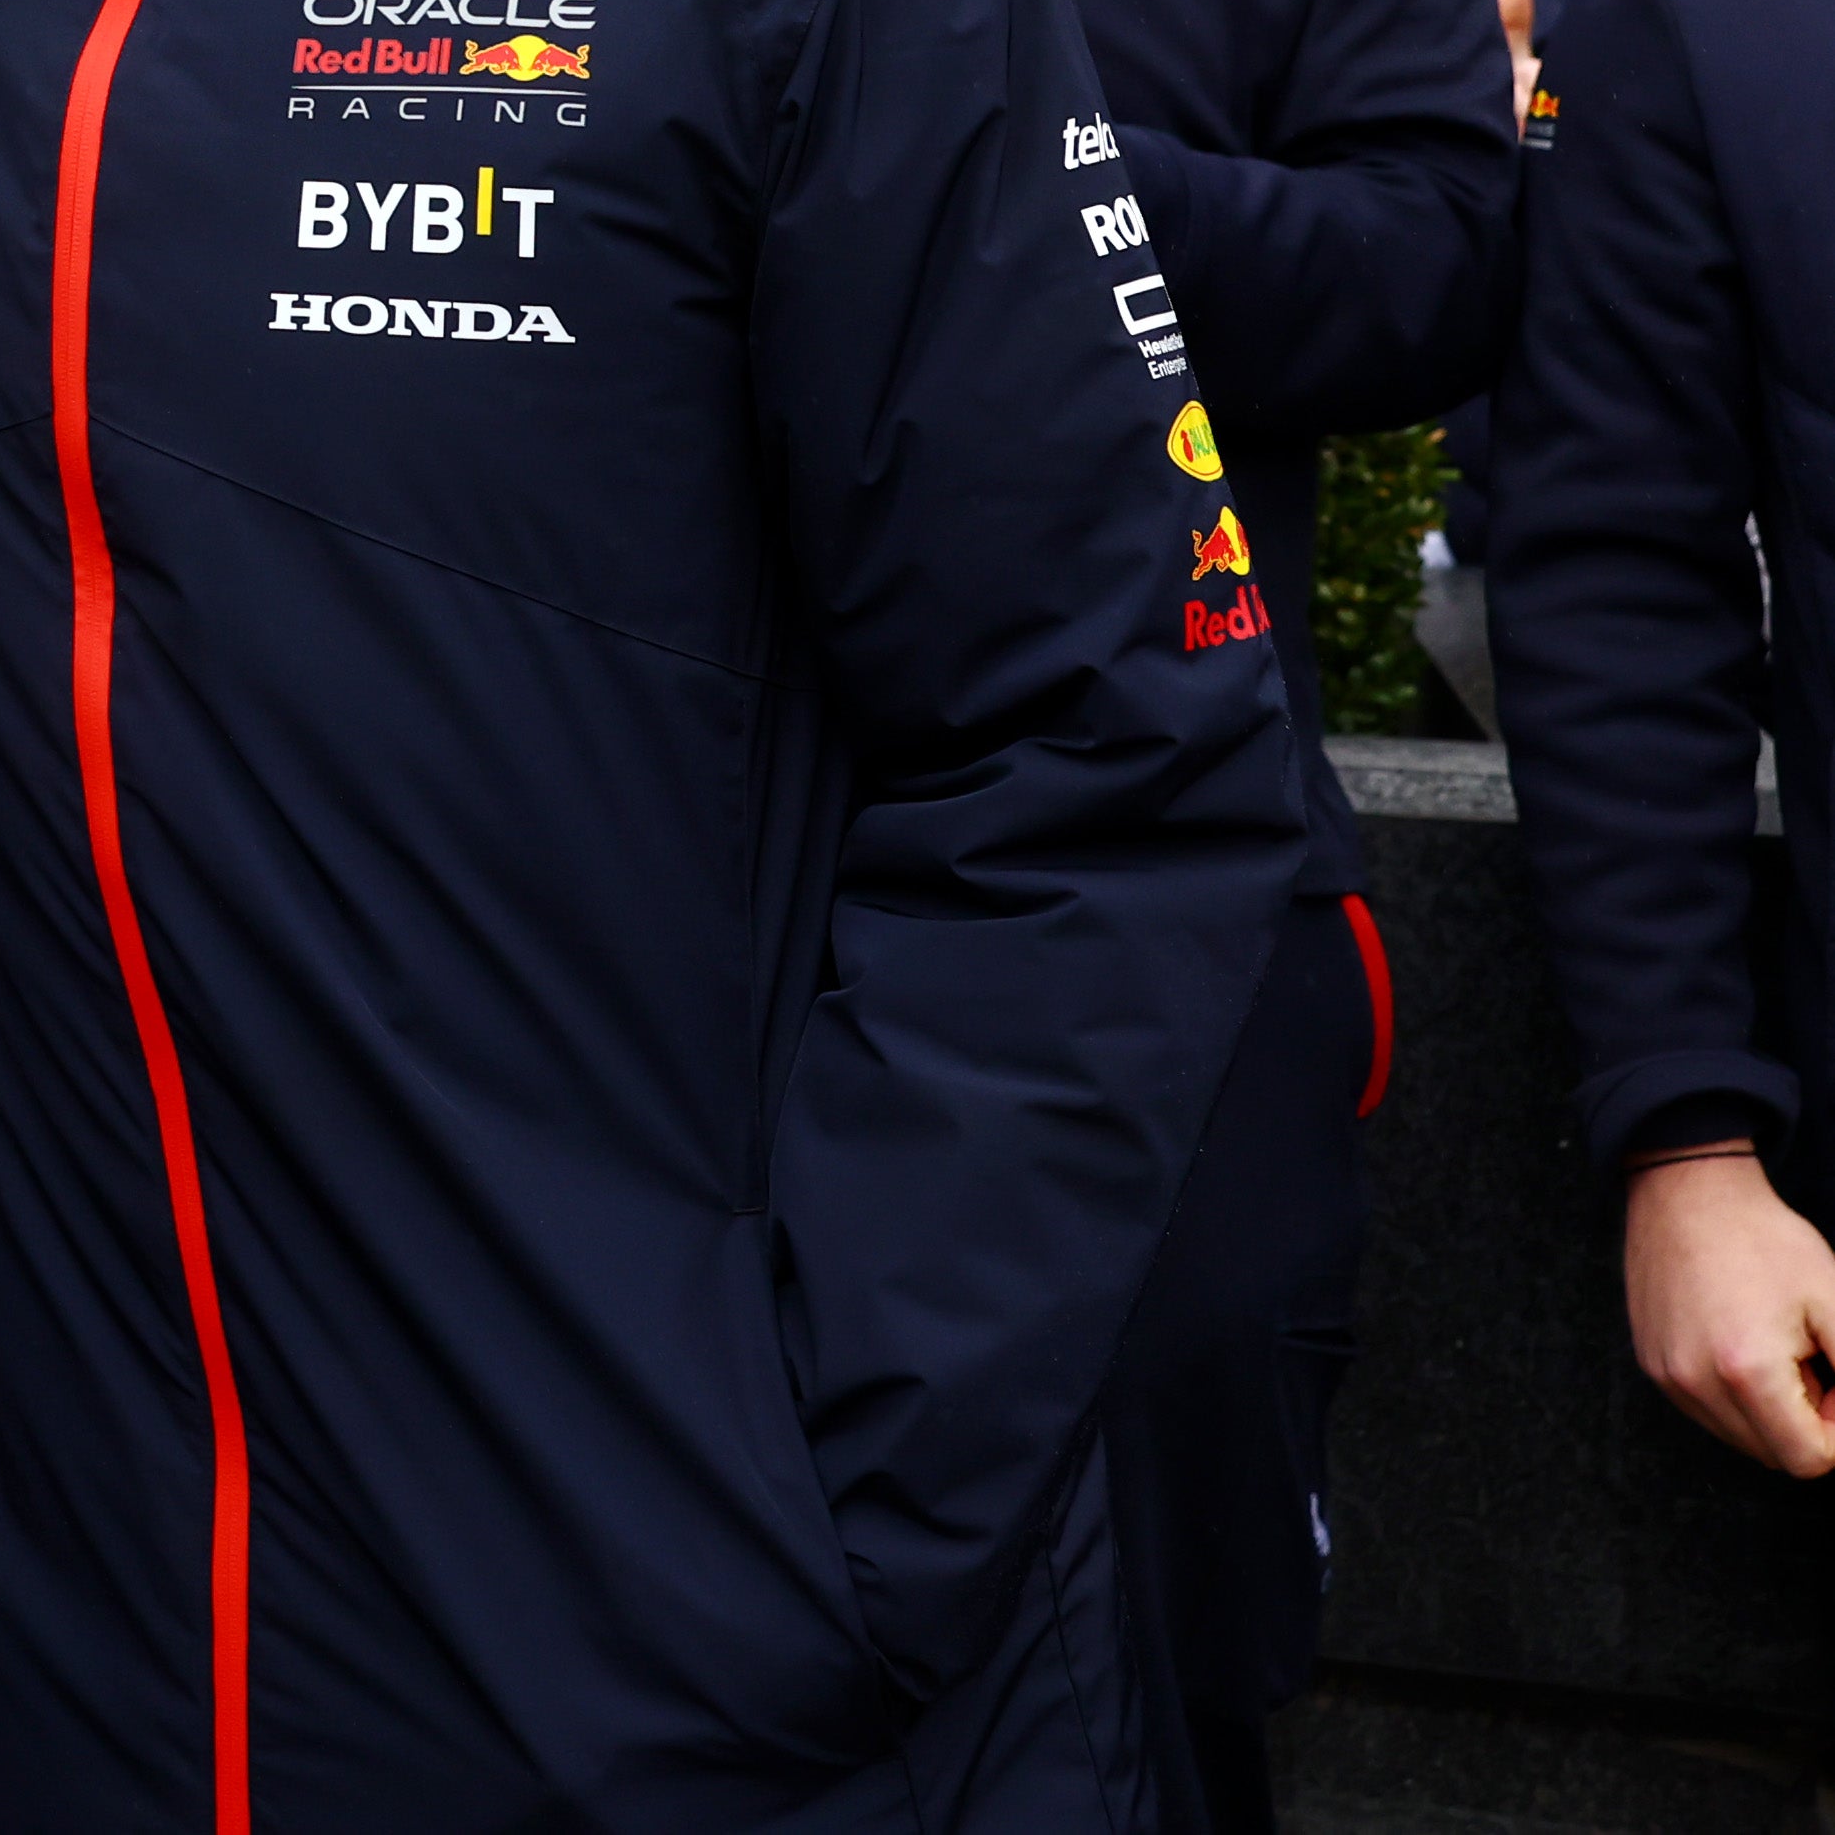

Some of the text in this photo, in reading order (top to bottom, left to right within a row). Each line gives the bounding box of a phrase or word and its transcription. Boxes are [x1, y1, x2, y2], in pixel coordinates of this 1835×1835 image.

[292, 38, 452, 75] Red Bull
[287, 97, 587, 127] RACING
[296, 166, 554, 258] BYBIT
[267, 292, 576, 343] HONDA
[1184, 584, 1257, 652] Red
